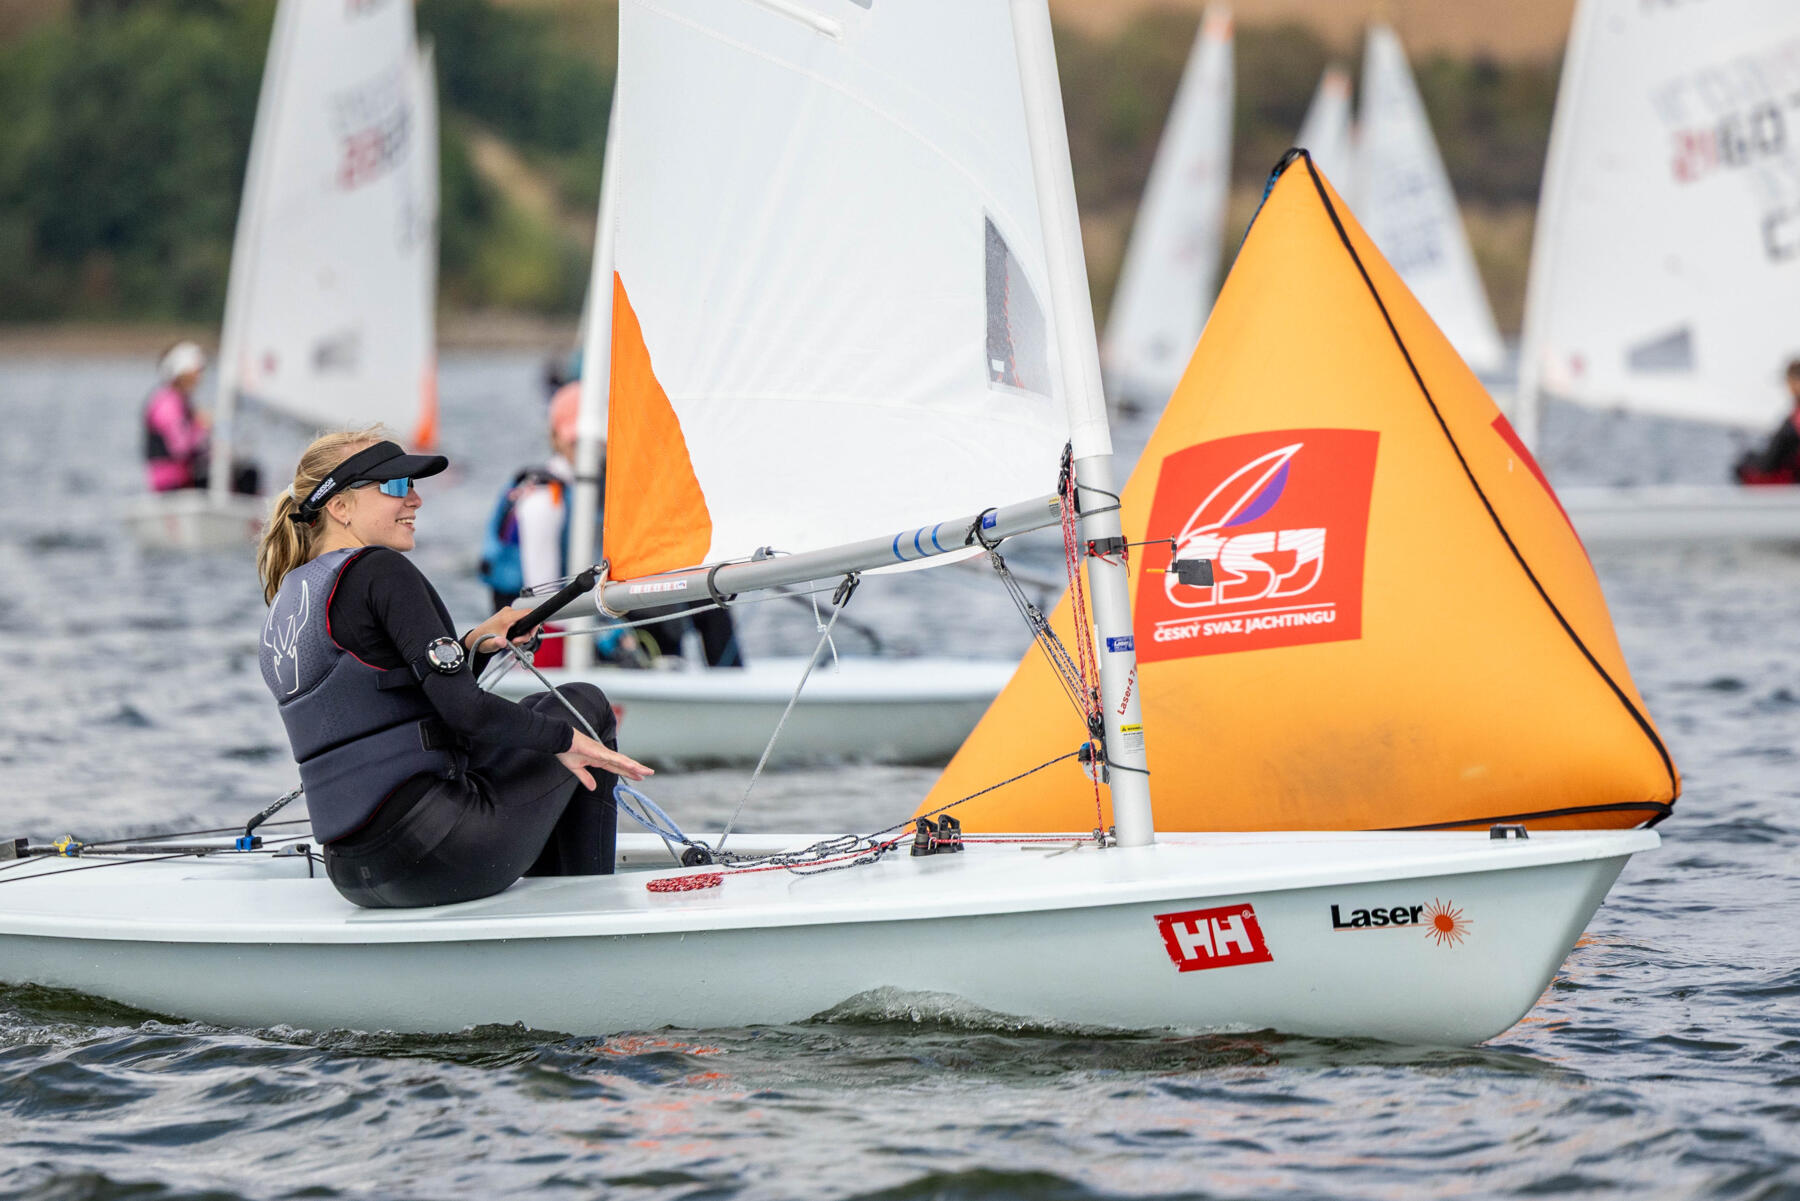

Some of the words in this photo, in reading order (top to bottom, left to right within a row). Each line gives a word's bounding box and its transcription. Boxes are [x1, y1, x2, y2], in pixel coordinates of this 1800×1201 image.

[1153, 622, 1201, 642] ČESKÝ
[1203, 620, 1244, 636] SVAZ
[1245, 610, 1336, 634] JACHTINGU
[1117, 686, 1131, 715] Laser
[1331, 904, 1423, 928] Laser
